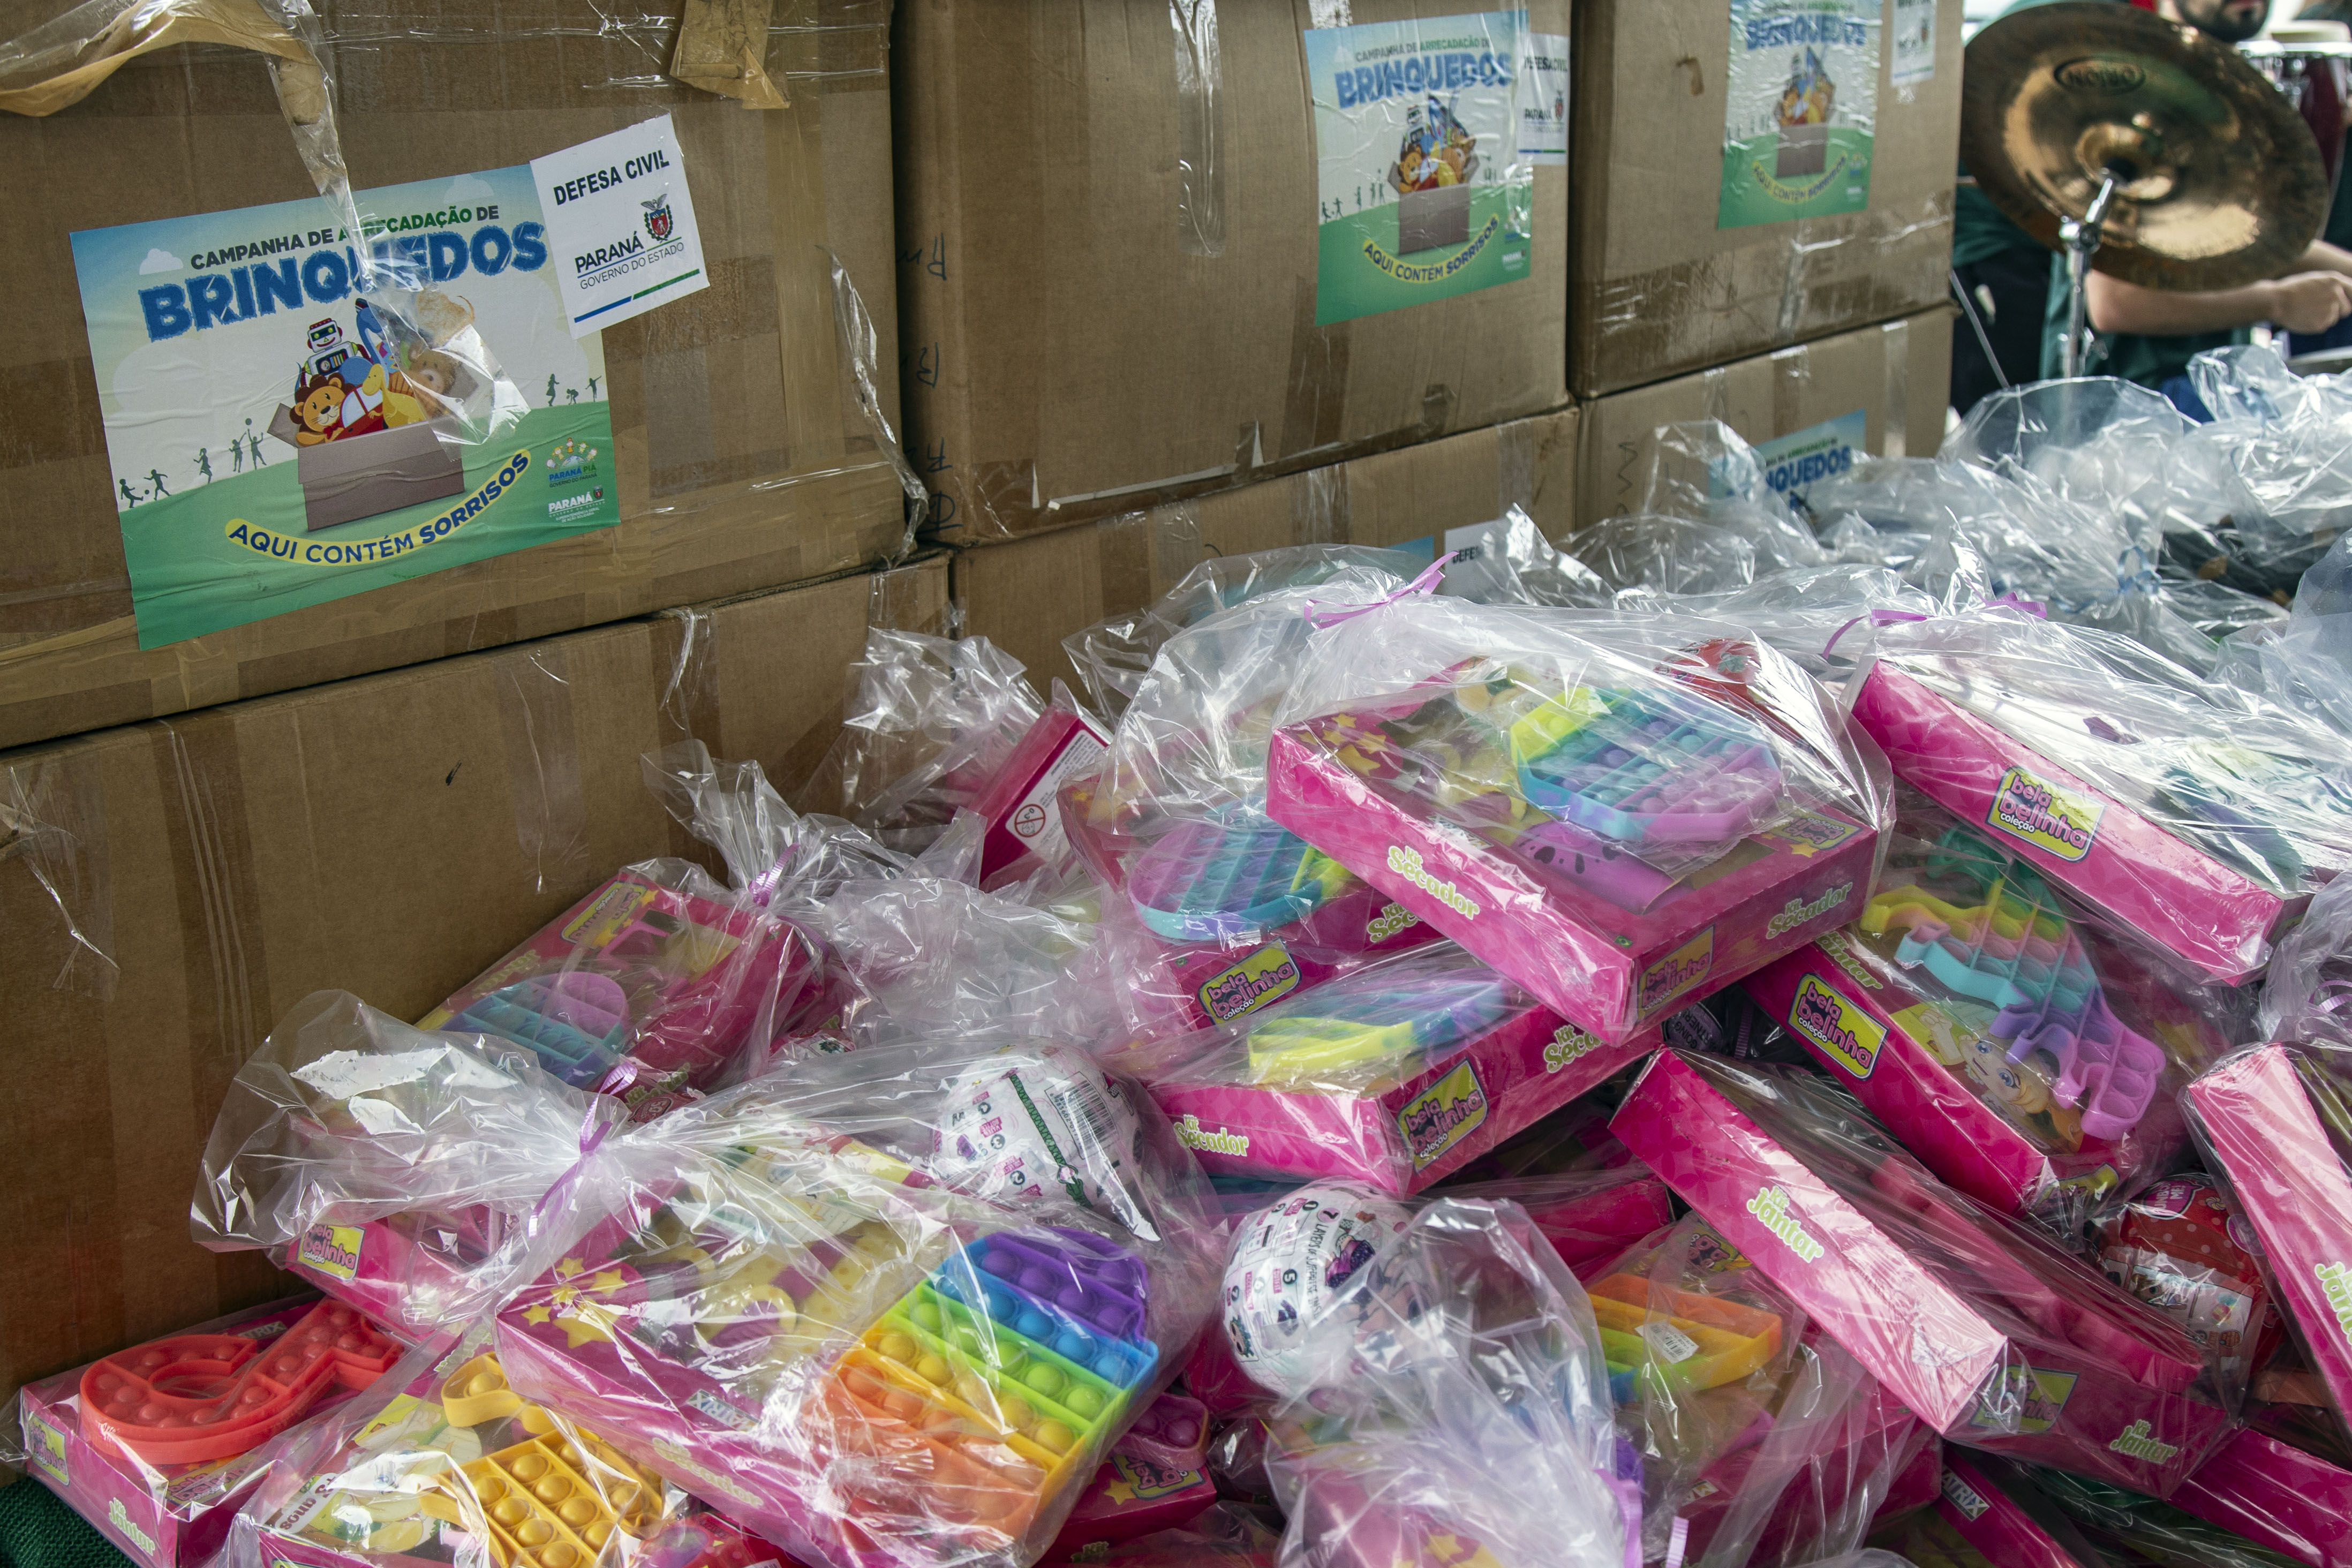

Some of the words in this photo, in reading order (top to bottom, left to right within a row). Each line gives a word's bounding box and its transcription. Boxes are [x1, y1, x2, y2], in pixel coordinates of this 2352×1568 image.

[1356, 43, 1403, 63] CAMPANHA
[1406, 42, 1417, 54] DE
[1420, 34, 1479, 51] ARRECADAÇÃO
[1335, 51, 1512, 109] BRINQUEDOS
[553, 167, 622, 206] DEFESA
[625, 149, 669, 179] CIVIL
[191, 234, 303, 269] CAMPANHA
[309, 228, 334, 247] DE
[477, 205, 499, 221] DE
[575, 231, 644, 273] PARANÁ
[1365, 244, 1392, 273] AQUI
[1396, 263, 1444, 282] CONTÉM
[1446, 217, 1498, 275] SORRISOS
[579, 262, 630, 289] GOVERNO
[631, 258, 646, 270] DO
[647, 242, 684, 267] ESTADO
[549, 466, 582, 481] PARANÁ
[549, 478, 571, 488] GOVERNO
[228, 524, 297, 559] AQUI
[306, 532, 413, 564] CONTÉM
[419, 453, 529, 544] SORRISOS
[548, 491, 593, 512] PARANÁ
[2010, 774, 2052, 809] bela
[2000, 793, 2089, 849] belinha
[2000, 811, 2036, 833] coleção
[1404, 845, 1423, 869] Kit
[1388, 845, 1480, 920] Secador
[1766, 883, 1853, 939] Secador
[1815, 936, 1884, 990] antar
[1208, 973, 1247, 1001] bela
[1211, 962, 1295, 1017] belinha
[1807, 982, 1842, 1017] bela
[1223, 997, 1255, 1021] coleção
[1555, 1025, 1575, 1047] Kit
[1797, 992, 1873, 1071] belinha
[1798, 1016, 1828, 1043] coleção
[1544, 1032, 1603, 1074] Seca
[1405, 1097, 1441, 1129] bela
[1408, 1089, 1482, 1149] belinha
[992, 1136, 1001, 1147] 3
[1174, 1122, 1249, 1157] Secador
[1420, 1132, 1448, 1158] coleção
[1013, 1173, 1022, 1183] 2
[2169, 1185, 2186, 1200] ME!
[1769, 1186, 1790, 1211] Kit
[1323, 1210, 1339, 1220] 7
[303, 1233, 357, 1270] belinha
[1308, 1223, 1329, 1249] LAYERS
[303, 1251, 325, 1264] coleção
[1284, 1272, 1295, 1283] 5
